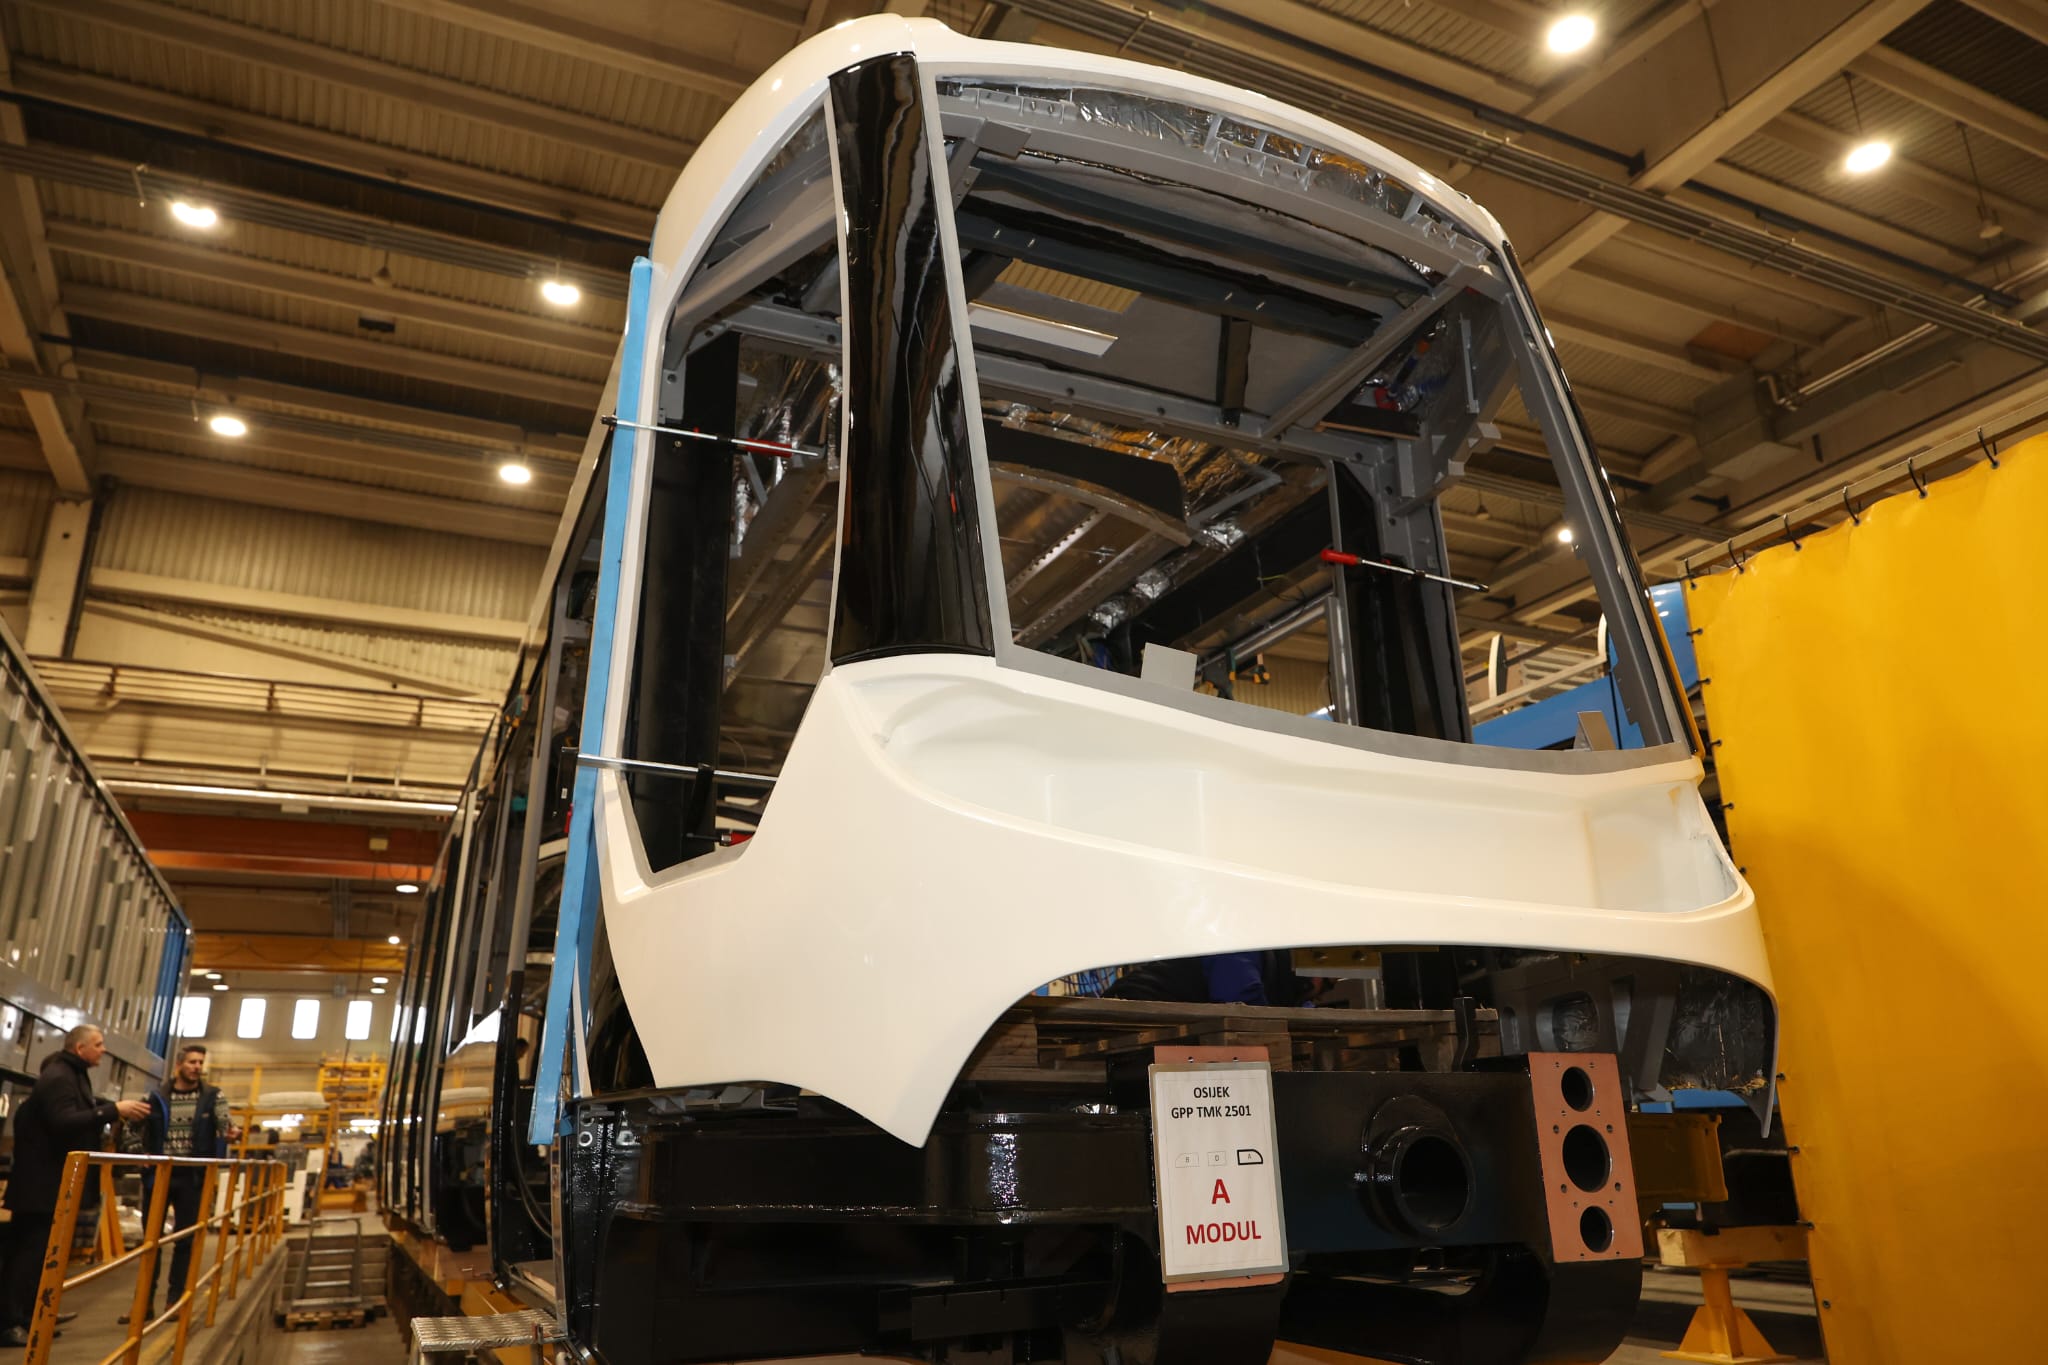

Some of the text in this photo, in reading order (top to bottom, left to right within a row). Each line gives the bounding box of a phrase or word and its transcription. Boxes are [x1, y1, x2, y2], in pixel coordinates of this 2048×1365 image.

[1193, 1086, 1230, 1099] OSIJEK
[1171, 1104, 1252, 1119] GPP TMK 2501
[1211, 1178, 1231, 1204] A
[1186, 1220, 1262, 1245] MODUL
